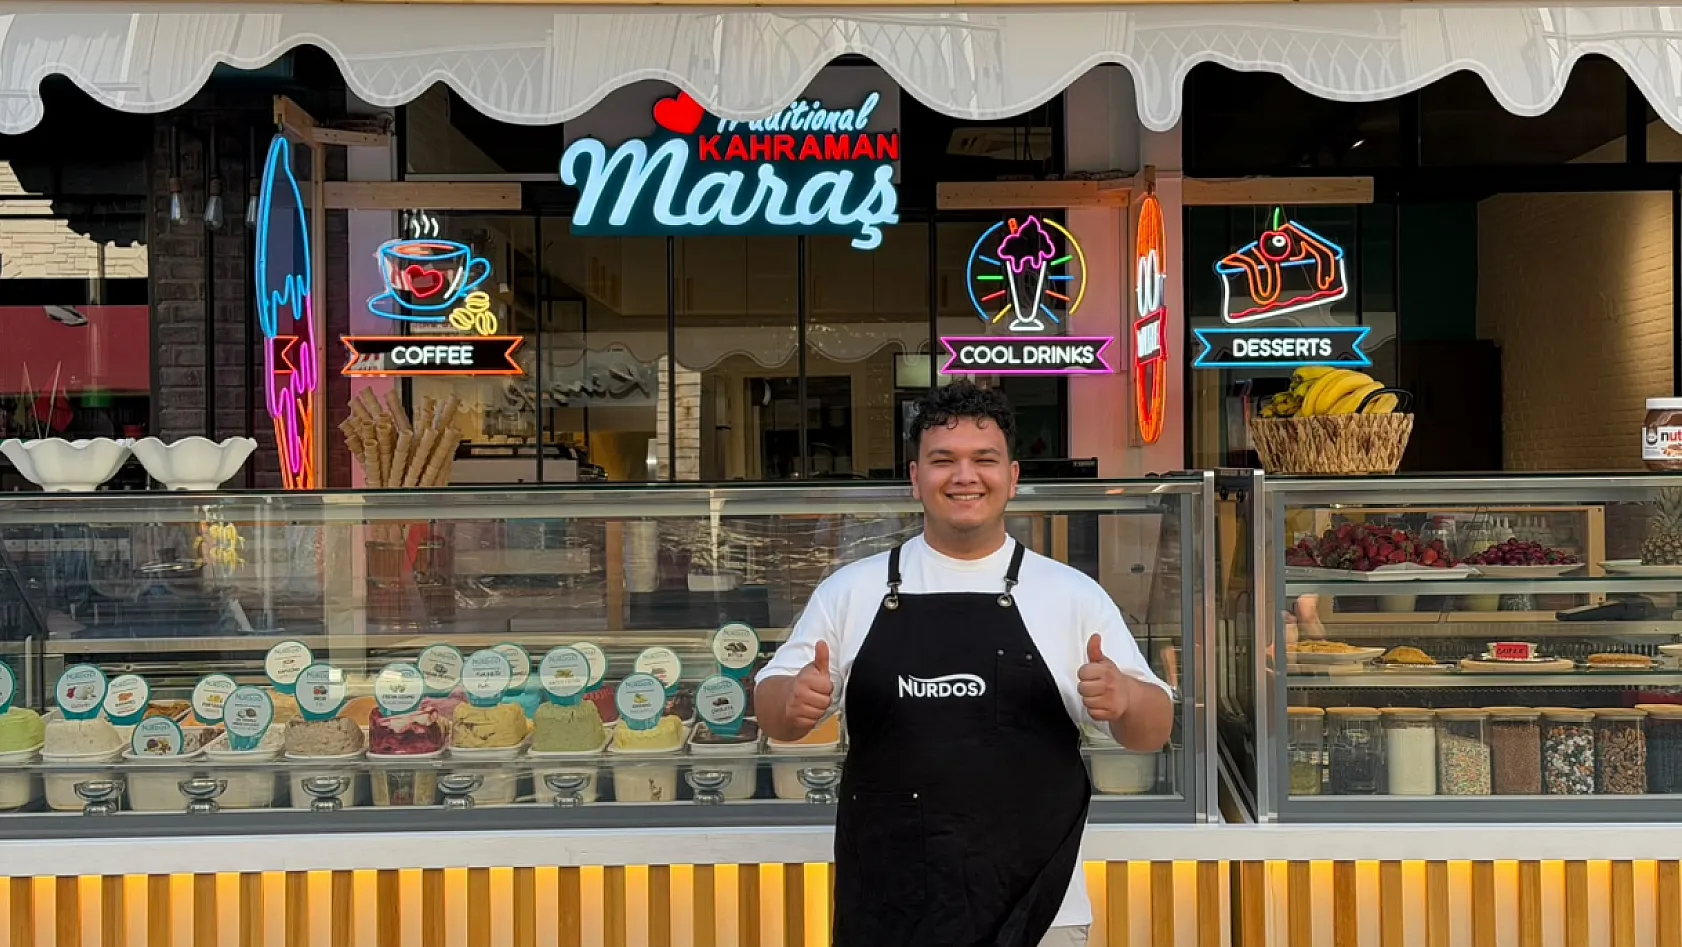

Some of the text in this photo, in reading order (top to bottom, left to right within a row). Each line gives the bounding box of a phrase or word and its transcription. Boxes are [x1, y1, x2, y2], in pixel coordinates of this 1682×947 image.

[699, 134, 899, 161] KAHRAMAN
[560, 138, 899, 250] Maraş
[390, 344, 474, 365] COFFEE
[960, 344, 1094, 364] COOL DRINKS
[1232, 337, 1333, 358] DESSERTS
[898, 674, 986, 698] NURDOS
